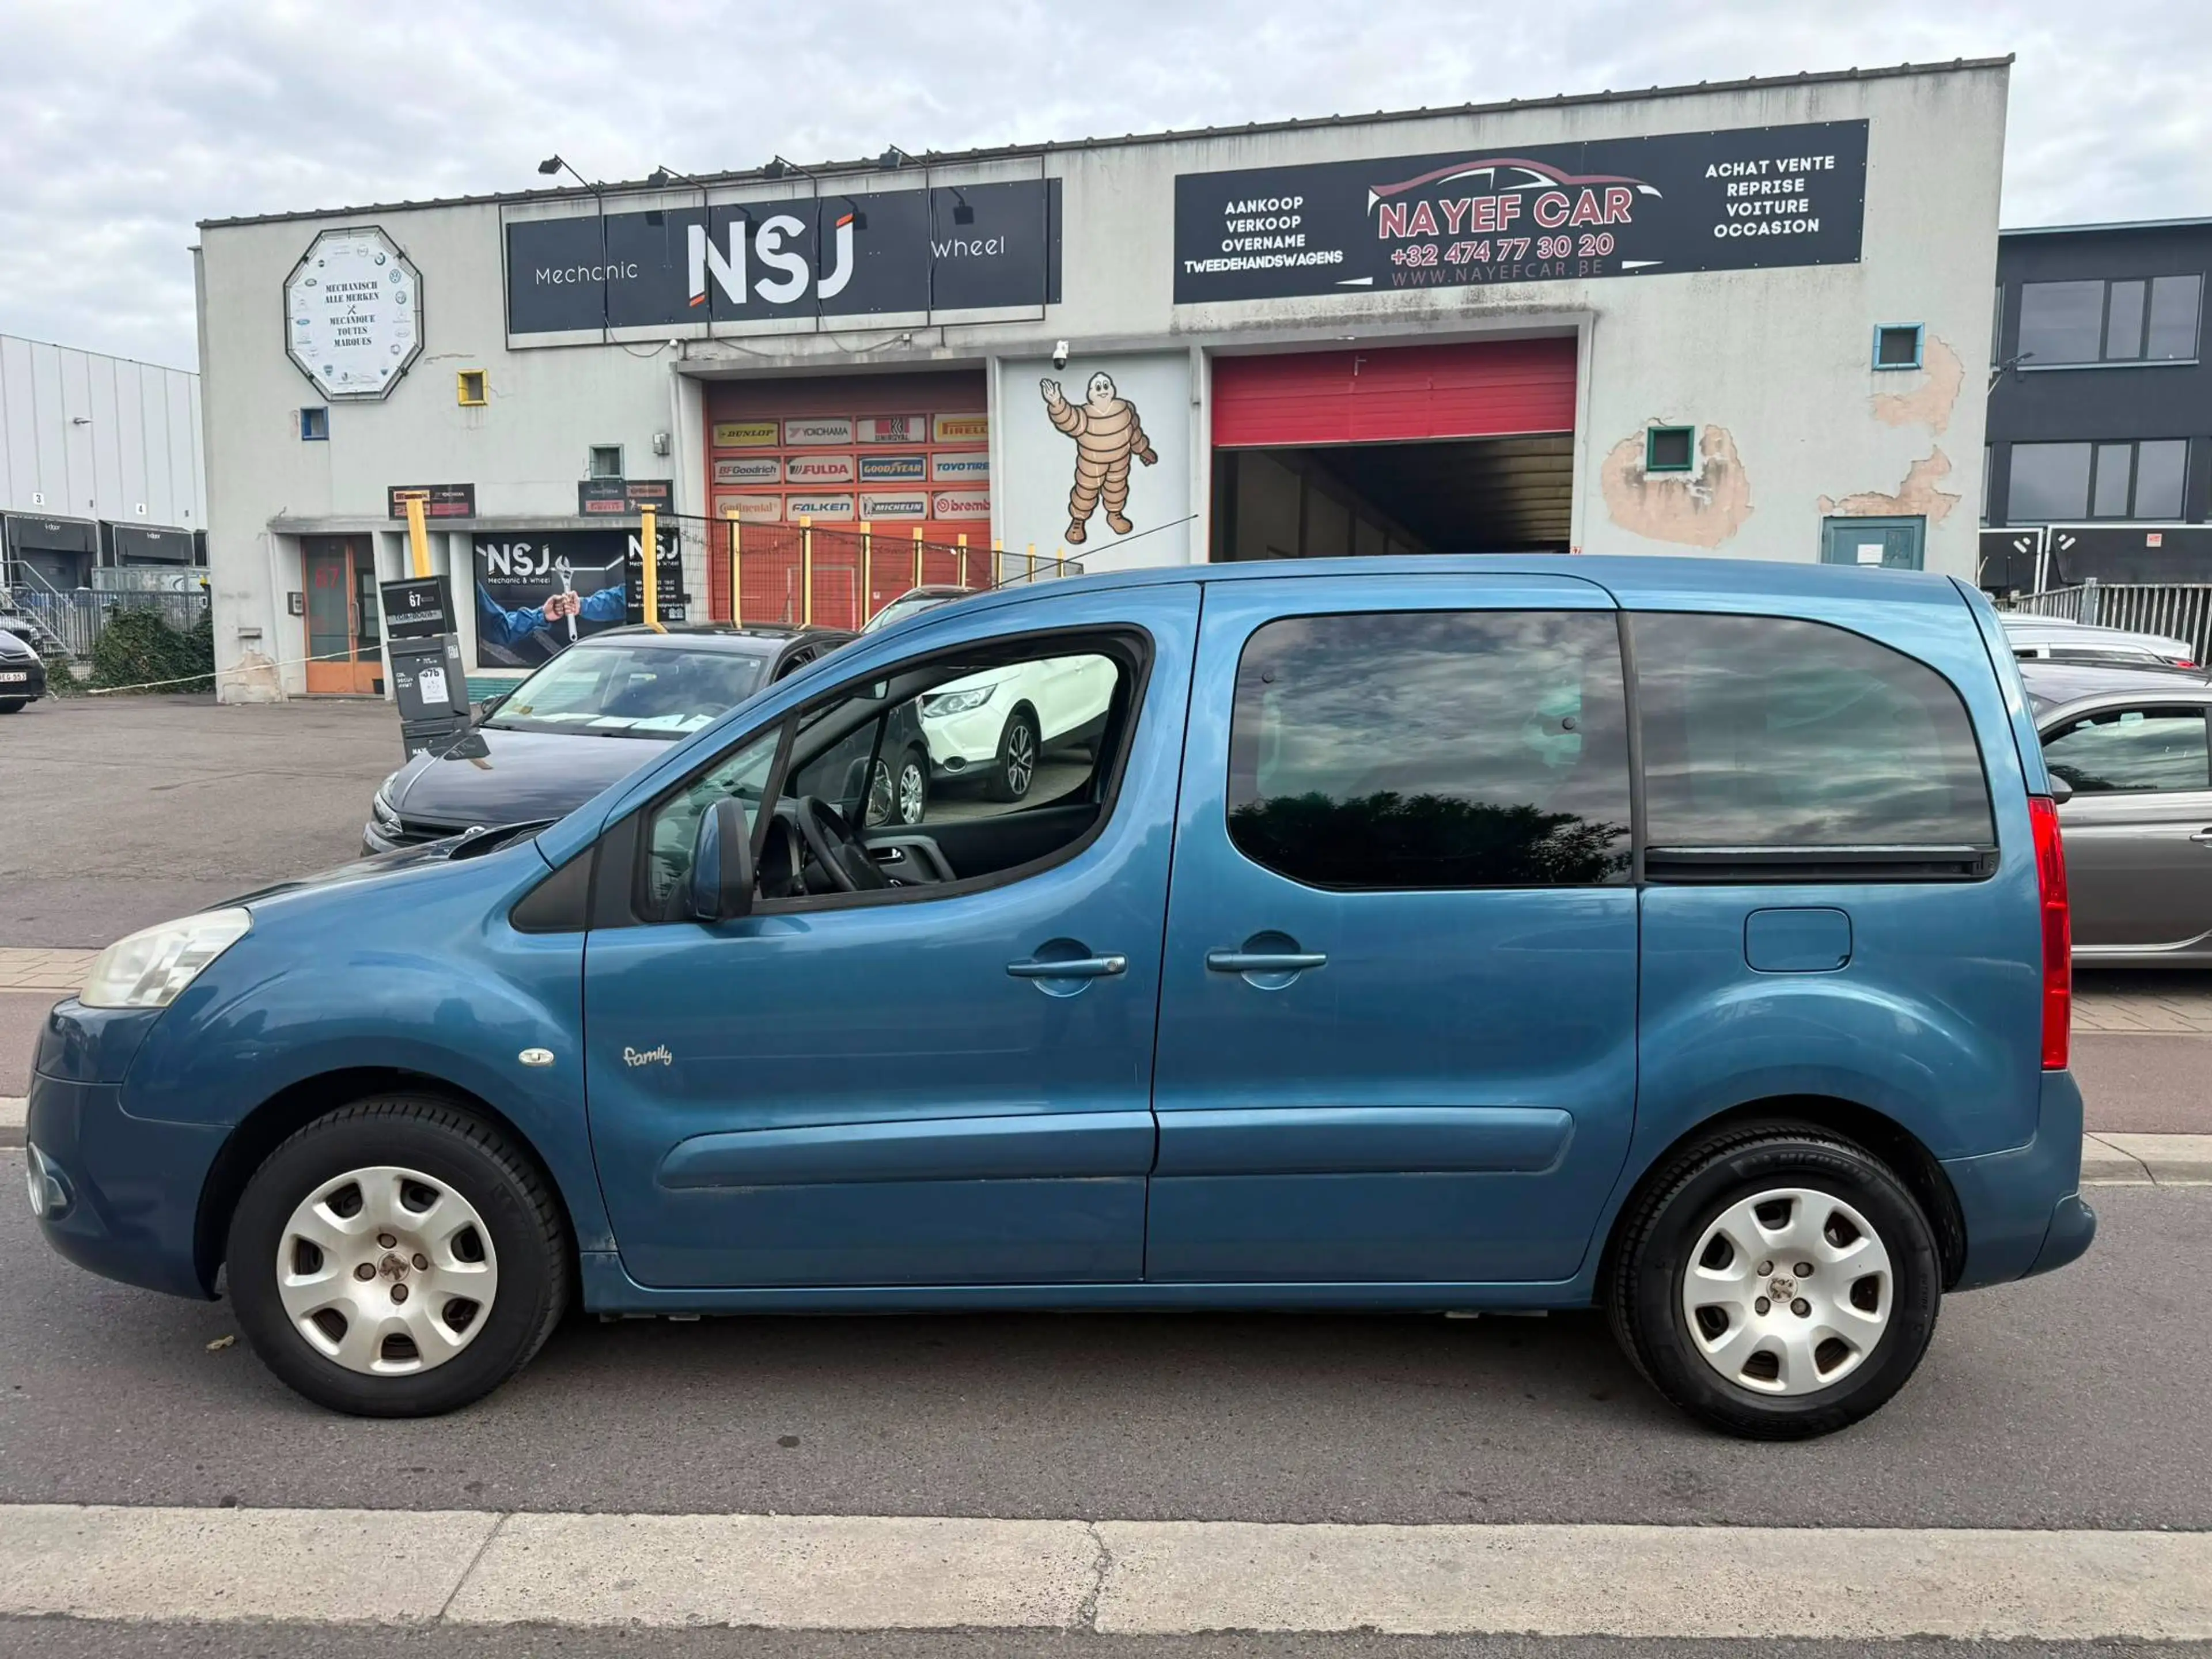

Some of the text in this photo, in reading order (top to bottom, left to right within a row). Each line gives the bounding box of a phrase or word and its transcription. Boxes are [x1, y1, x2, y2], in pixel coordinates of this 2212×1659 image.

[1705, 156, 1835, 178] ACHAT VENTE
[1727, 178, 1805, 196] REPRISE
[1225, 196, 1304, 215] AANKOOP
[1378, 187, 1633, 239] NAYEF CAR
[1726, 199, 1809, 217] VOITURE
[1226, 215, 1301, 233] VERKOOP
[1714, 218, 1820, 238] OCCASION
[931, 236, 1004, 258] Wheel
[1221, 234, 1306, 252] OVERNAME
[1391, 233, 1615, 267] +32 474 77 30 20
[688, 213, 854, 306] NSJ
[1184, 250, 1343, 274] TWEEDEHANDSWAGENS
[1391, 260, 1603, 286] WWW.NAYEFCAR.BE
[325, 281, 377, 293] MECHANISCH
[325, 292, 380, 303] ALLE MERKEN
[338, 327, 368, 336] TOUTES
[334, 337, 372, 347] MARQUES
[802, 427, 849, 437] YOKOHAMA
[942, 421, 987, 434] PIRELL
[719, 465, 777, 475] BFGoodrich
[801, 465, 849, 475] FULDA
[967, 462, 990, 470] TIRE
[36, 494, 41, 503] 3
[875, 503, 922, 511] MICHELIN
[951, 498, 990, 511] bremb
[487, 543, 550, 576] NSJ
[410, 594, 421, 607] 67
